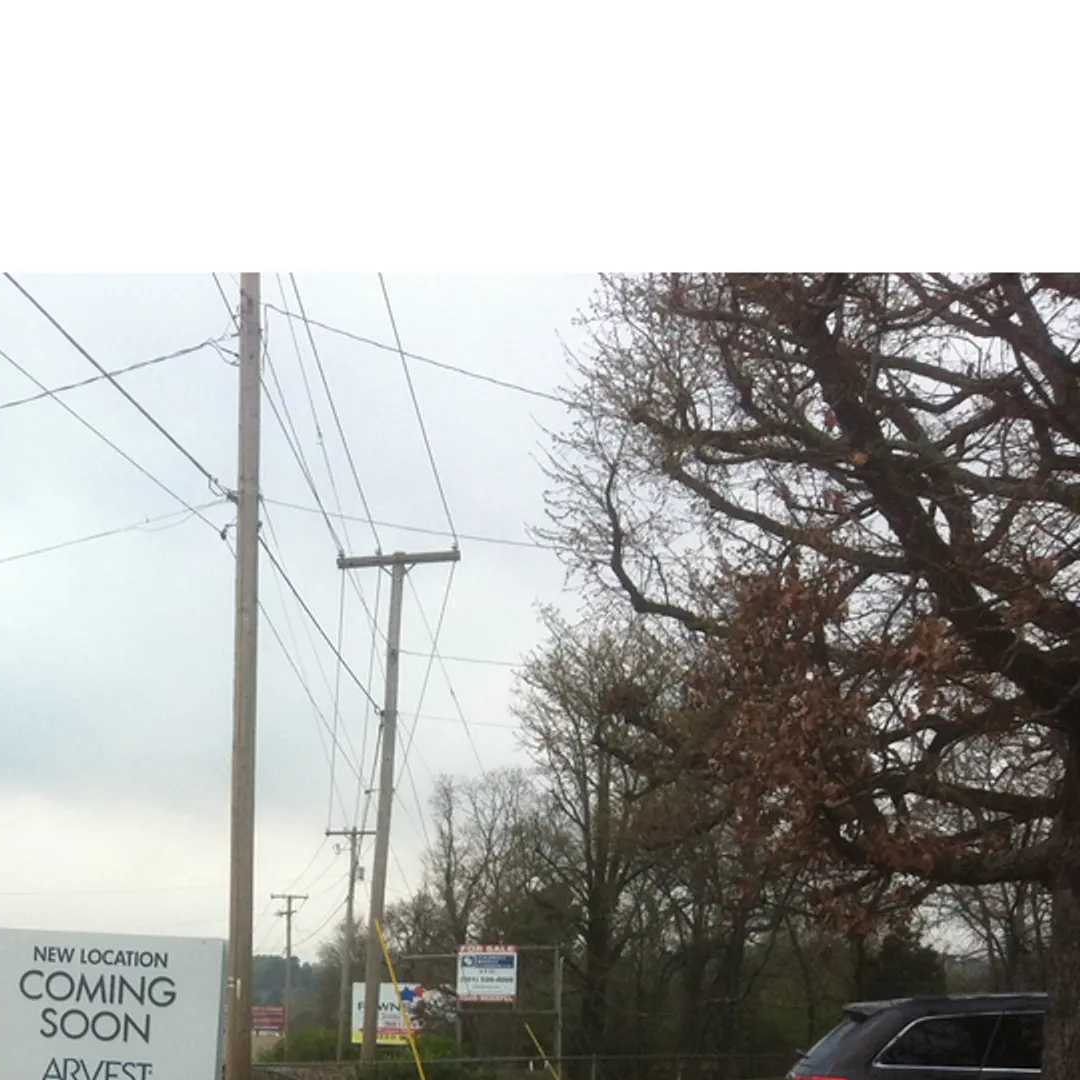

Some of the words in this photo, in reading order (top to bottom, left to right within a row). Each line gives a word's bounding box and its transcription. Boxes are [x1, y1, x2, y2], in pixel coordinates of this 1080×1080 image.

[33, 945, 76, 964] NEW
[80, 948, 169, 969] LOCATION
[19, 969, 177, 1008] COMING
[40, 1007, 151, 1044] SOON
